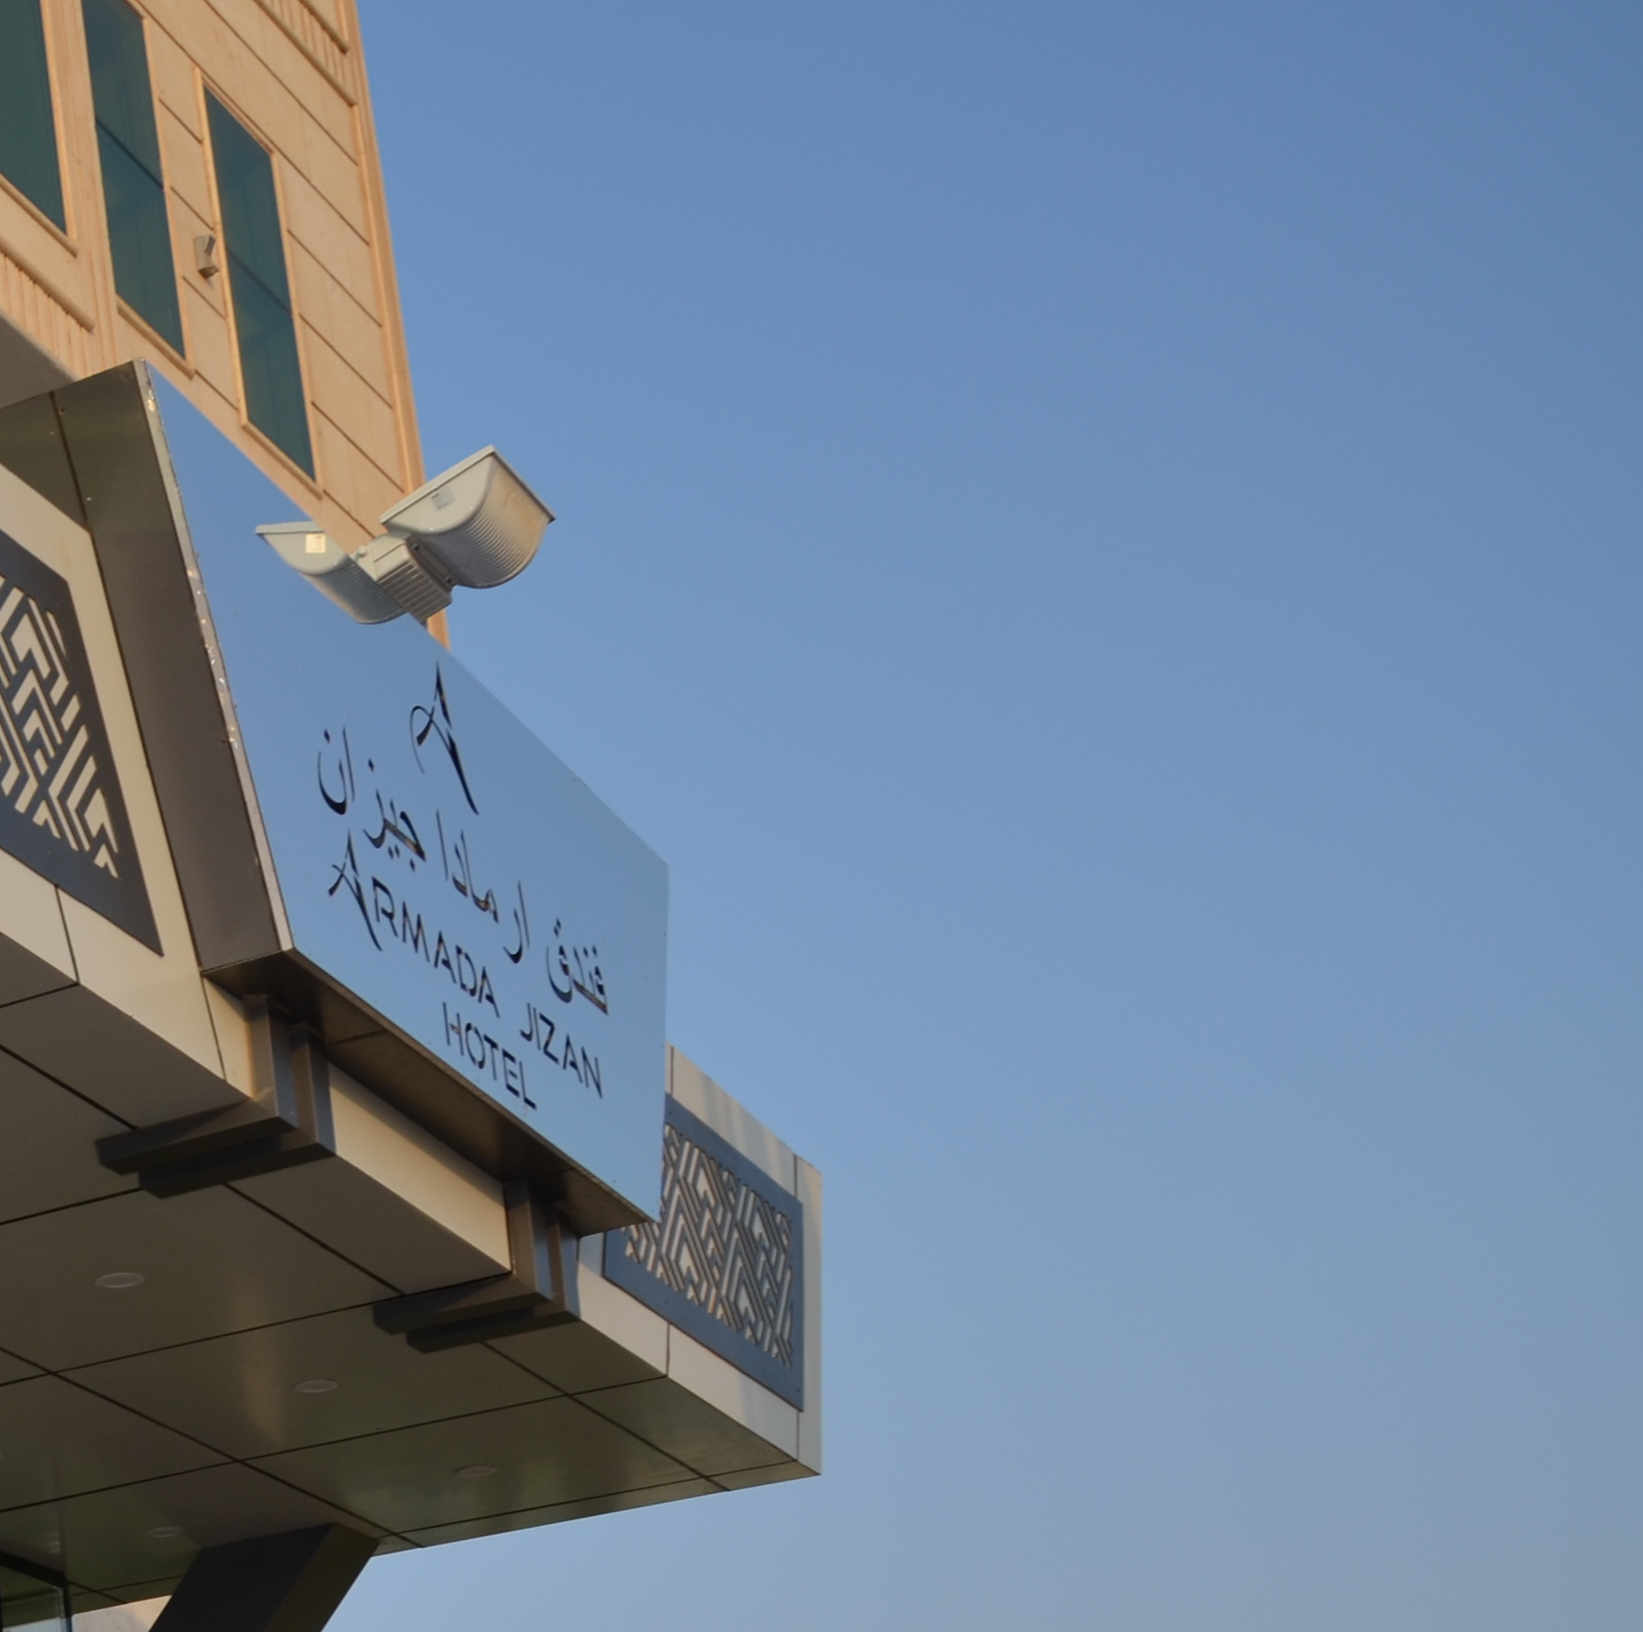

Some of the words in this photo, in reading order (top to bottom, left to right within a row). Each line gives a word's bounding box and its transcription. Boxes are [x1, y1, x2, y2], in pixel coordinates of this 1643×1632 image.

[328, 828, 500, 1019] ARMADA
[520, 1002, 603, 1099] JIZAN
[545, 917, 608, 1015] فندق
[442, 1001, 537, 1111] HOTEL
